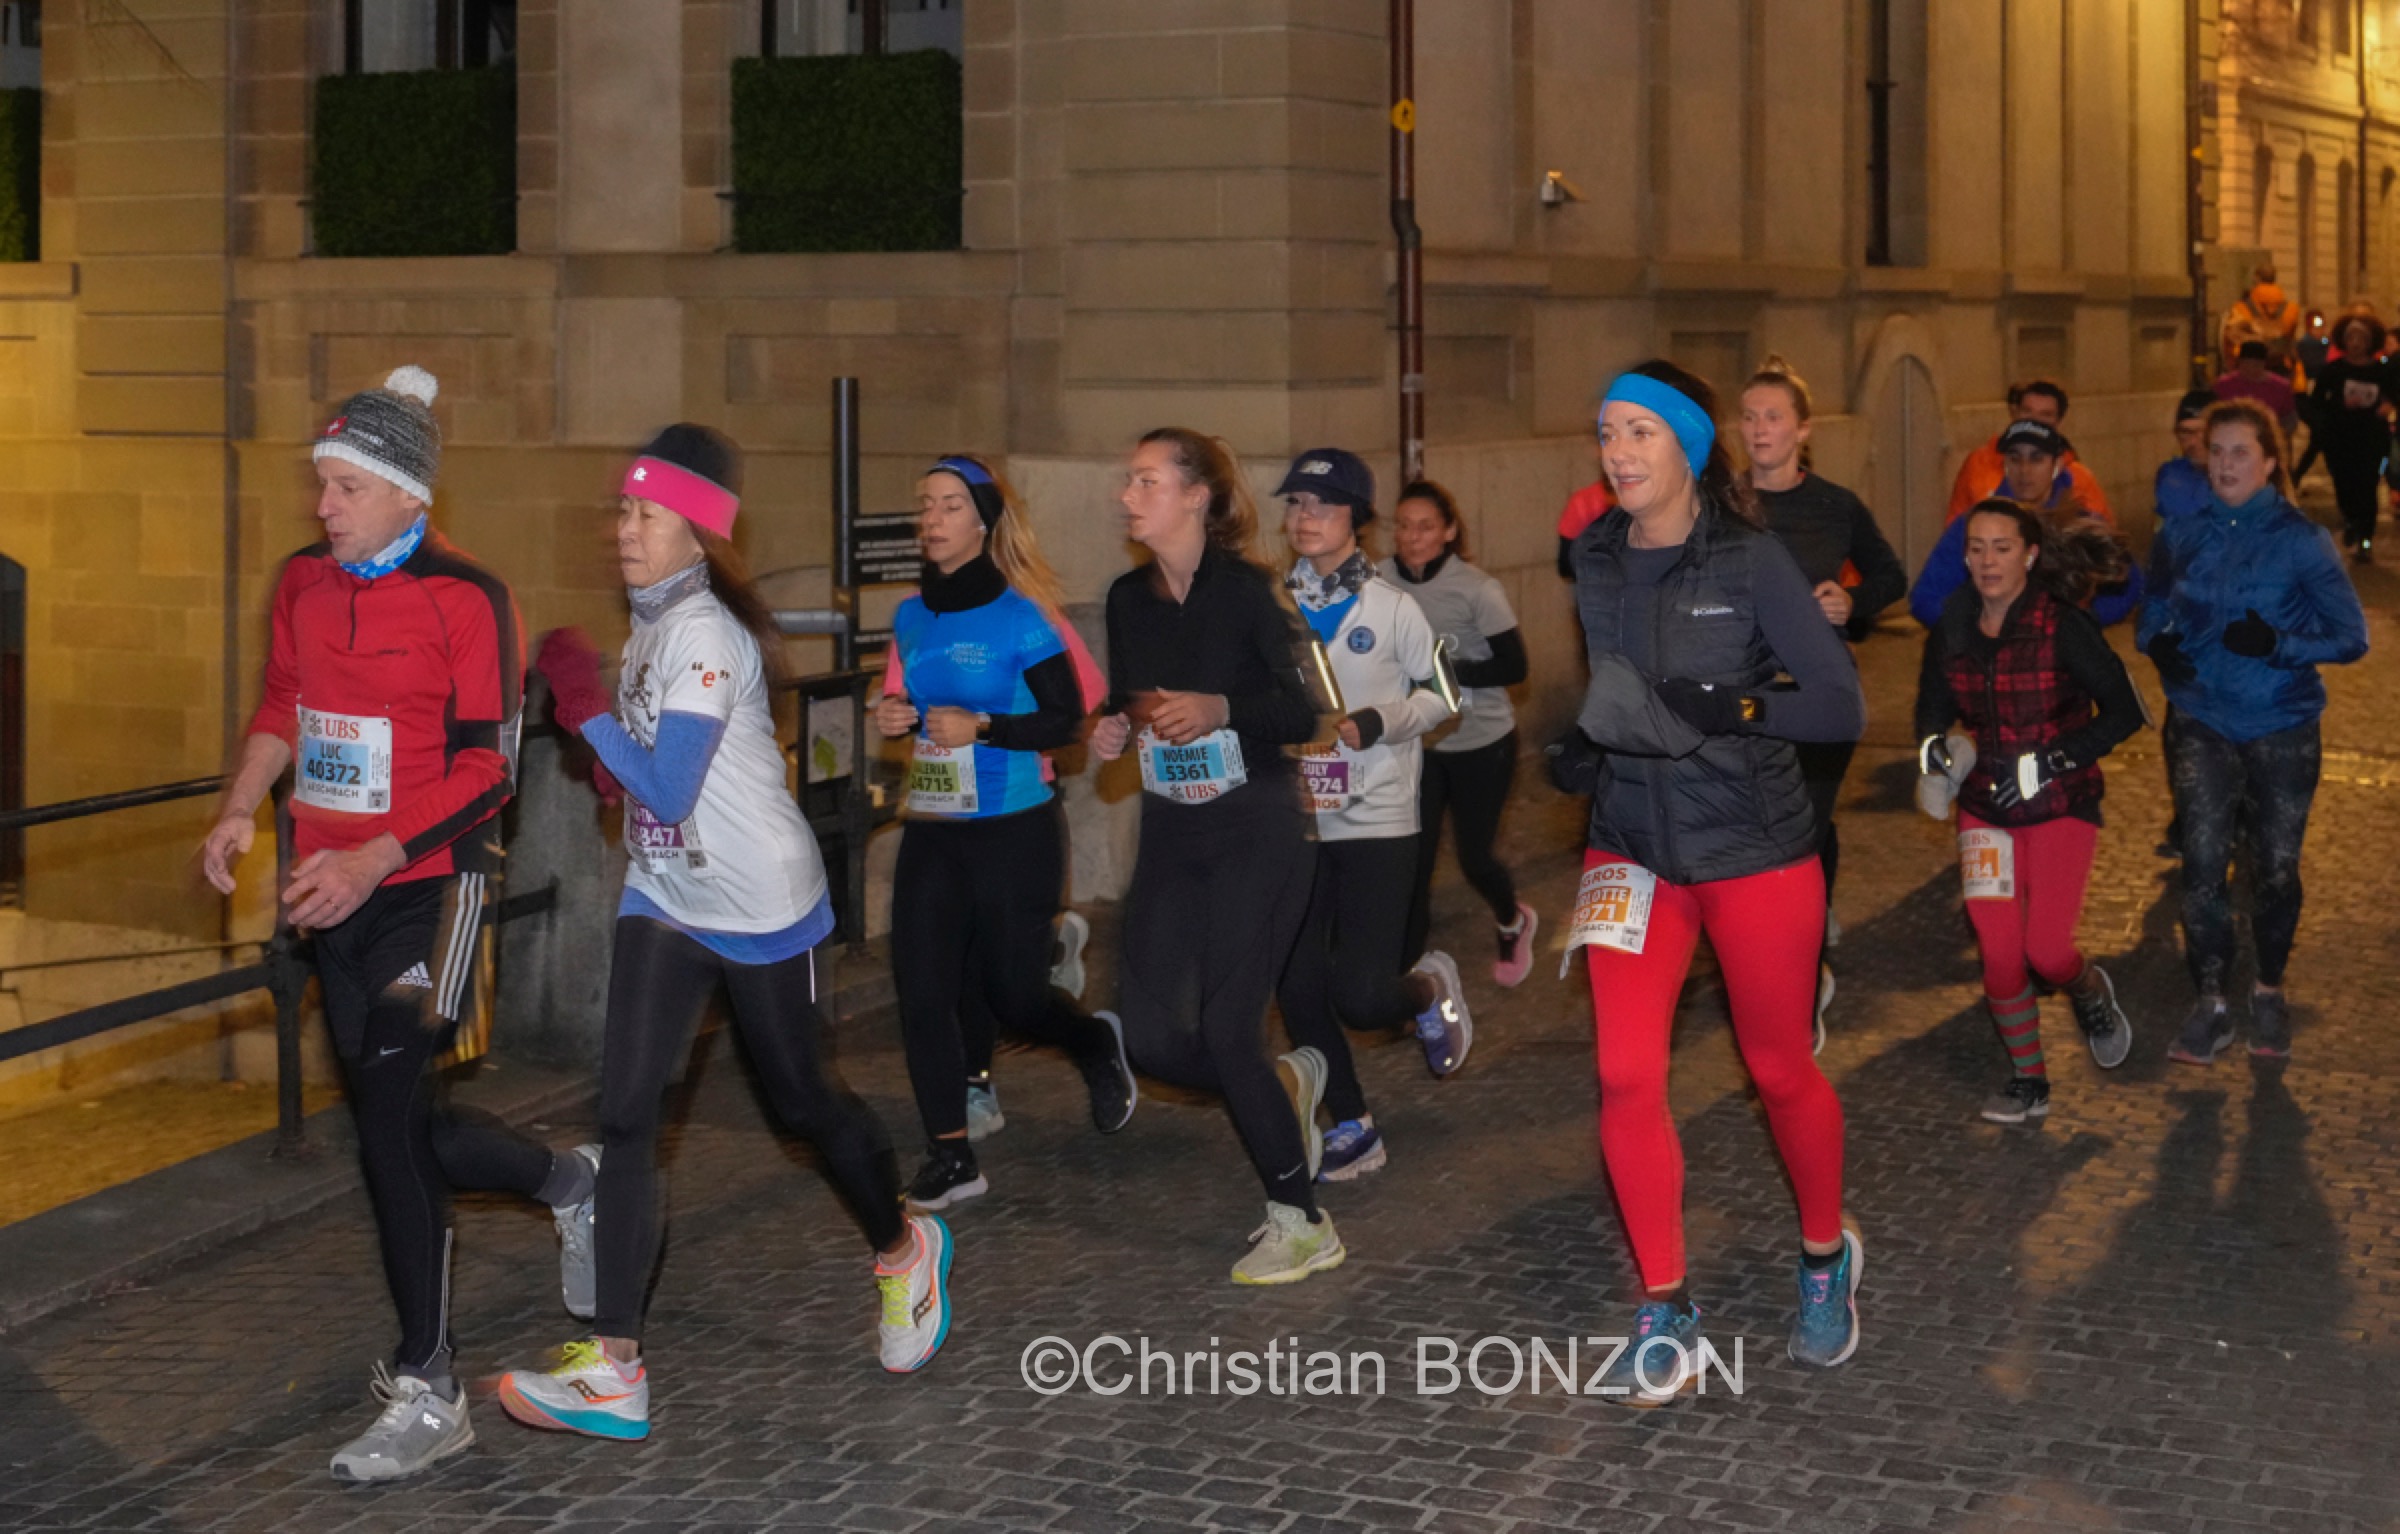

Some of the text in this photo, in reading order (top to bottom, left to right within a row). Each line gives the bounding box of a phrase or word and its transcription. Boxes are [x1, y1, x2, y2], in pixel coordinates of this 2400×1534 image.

[325, 718, 360, 740] UBS
[320, 742, 342, 760] LUC
[915, 743, 953, 757] GROS
[307, 757, 361, 785] 40372
[1165, 762, 1212, 781] 5361
[1184, 783, 1219, 800] UBS
[1306, 777, 1343, 793] 974
[1582, 867, 1628, 888] GROS
